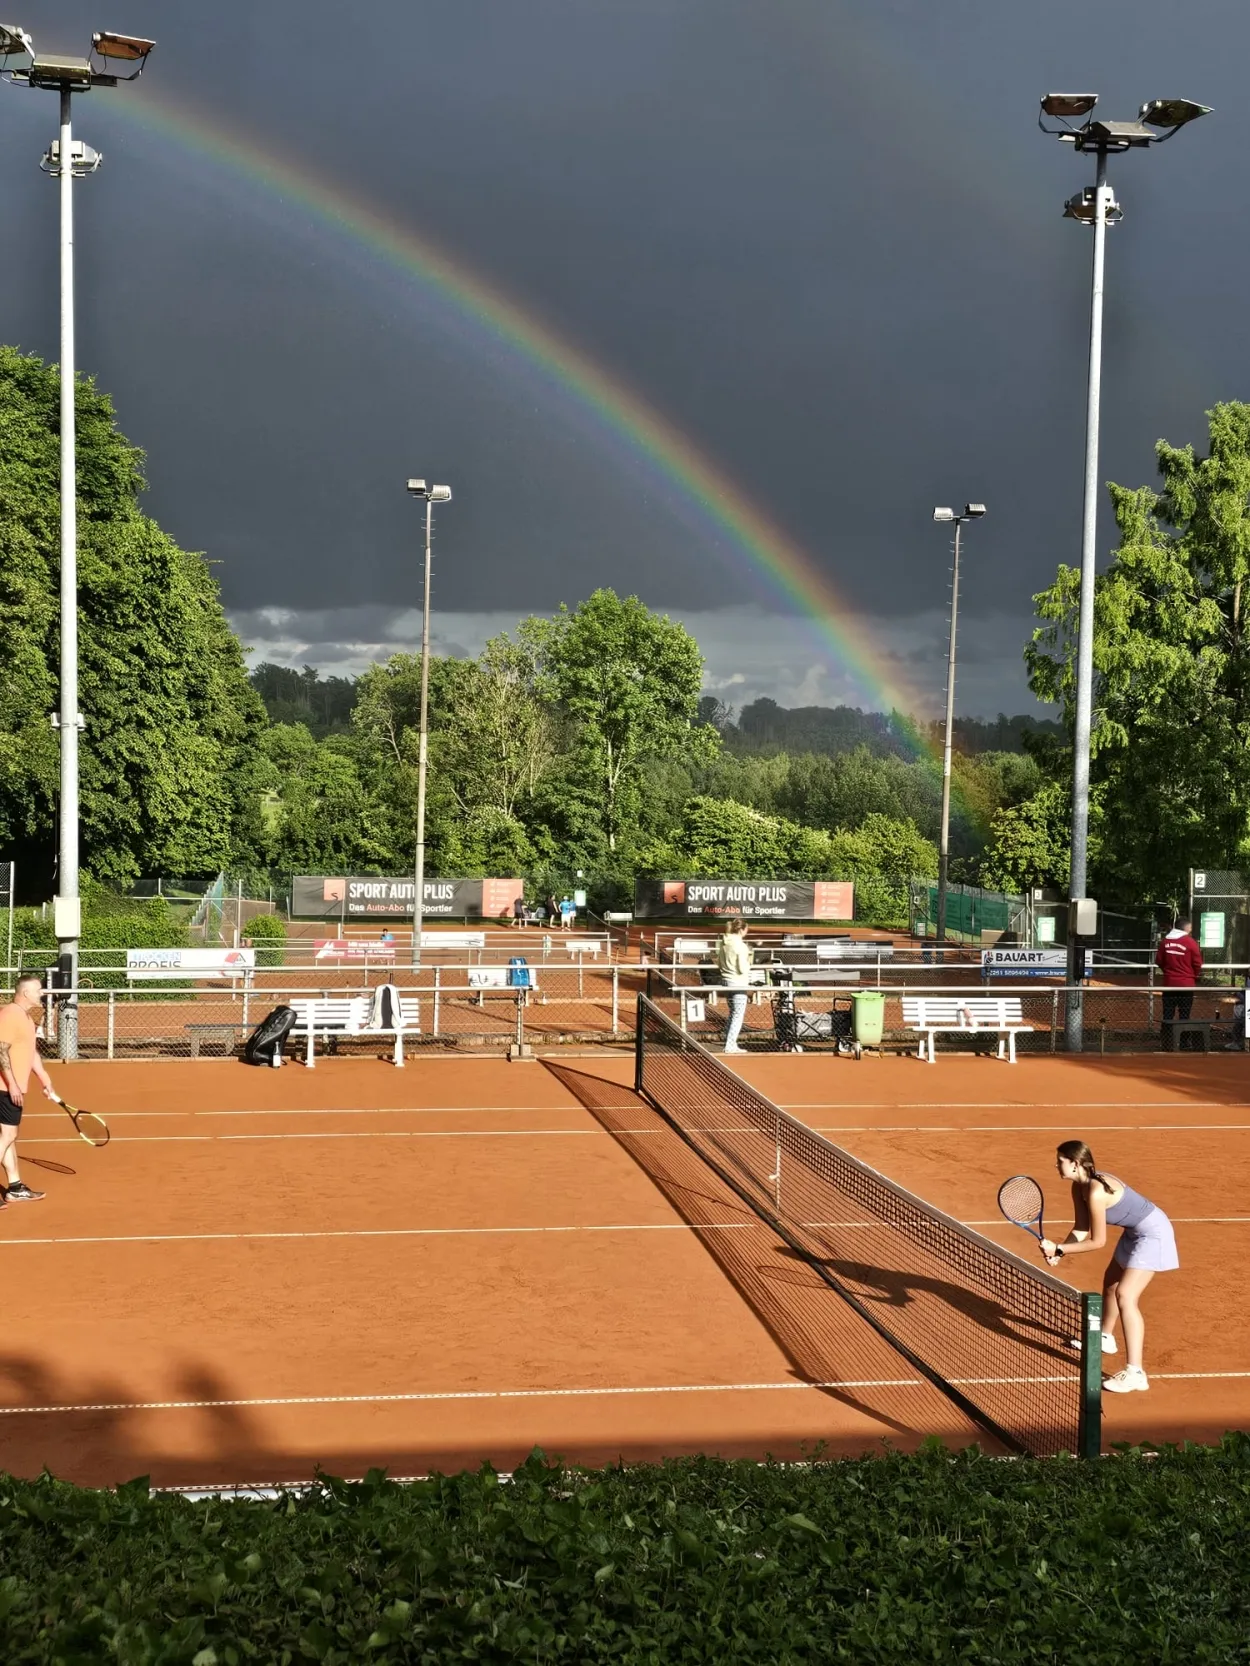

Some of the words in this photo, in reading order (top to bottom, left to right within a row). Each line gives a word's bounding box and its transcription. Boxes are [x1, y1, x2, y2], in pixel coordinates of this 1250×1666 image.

[1197, 876, 1204, 885] 2
[349, 883, 388, 898] SPORT
[389, 884, 415, 899] AUT
[424, 884, 454, 899] PLUS
[688, 886, 725, 901] SPORT
[727, 886, 756, 901] AUTO
[758, 887, 787, 902] PLUS
[349, 903, 365, 912] Das
[366, 904, 405, 912] Auto-Abo
[406, 904, 415, 912] fü
[420, 904, 453, 914] Sportler
[688, 906, 703, 914] Das
[704, 906, 740, 914] Auto-Abo
[742, 906, 754, 914] für
[755, 907, 786, 916] Sportler
[996, 953, 1043, 962] BAUART
[692, 1004, 698, 1017] 1
